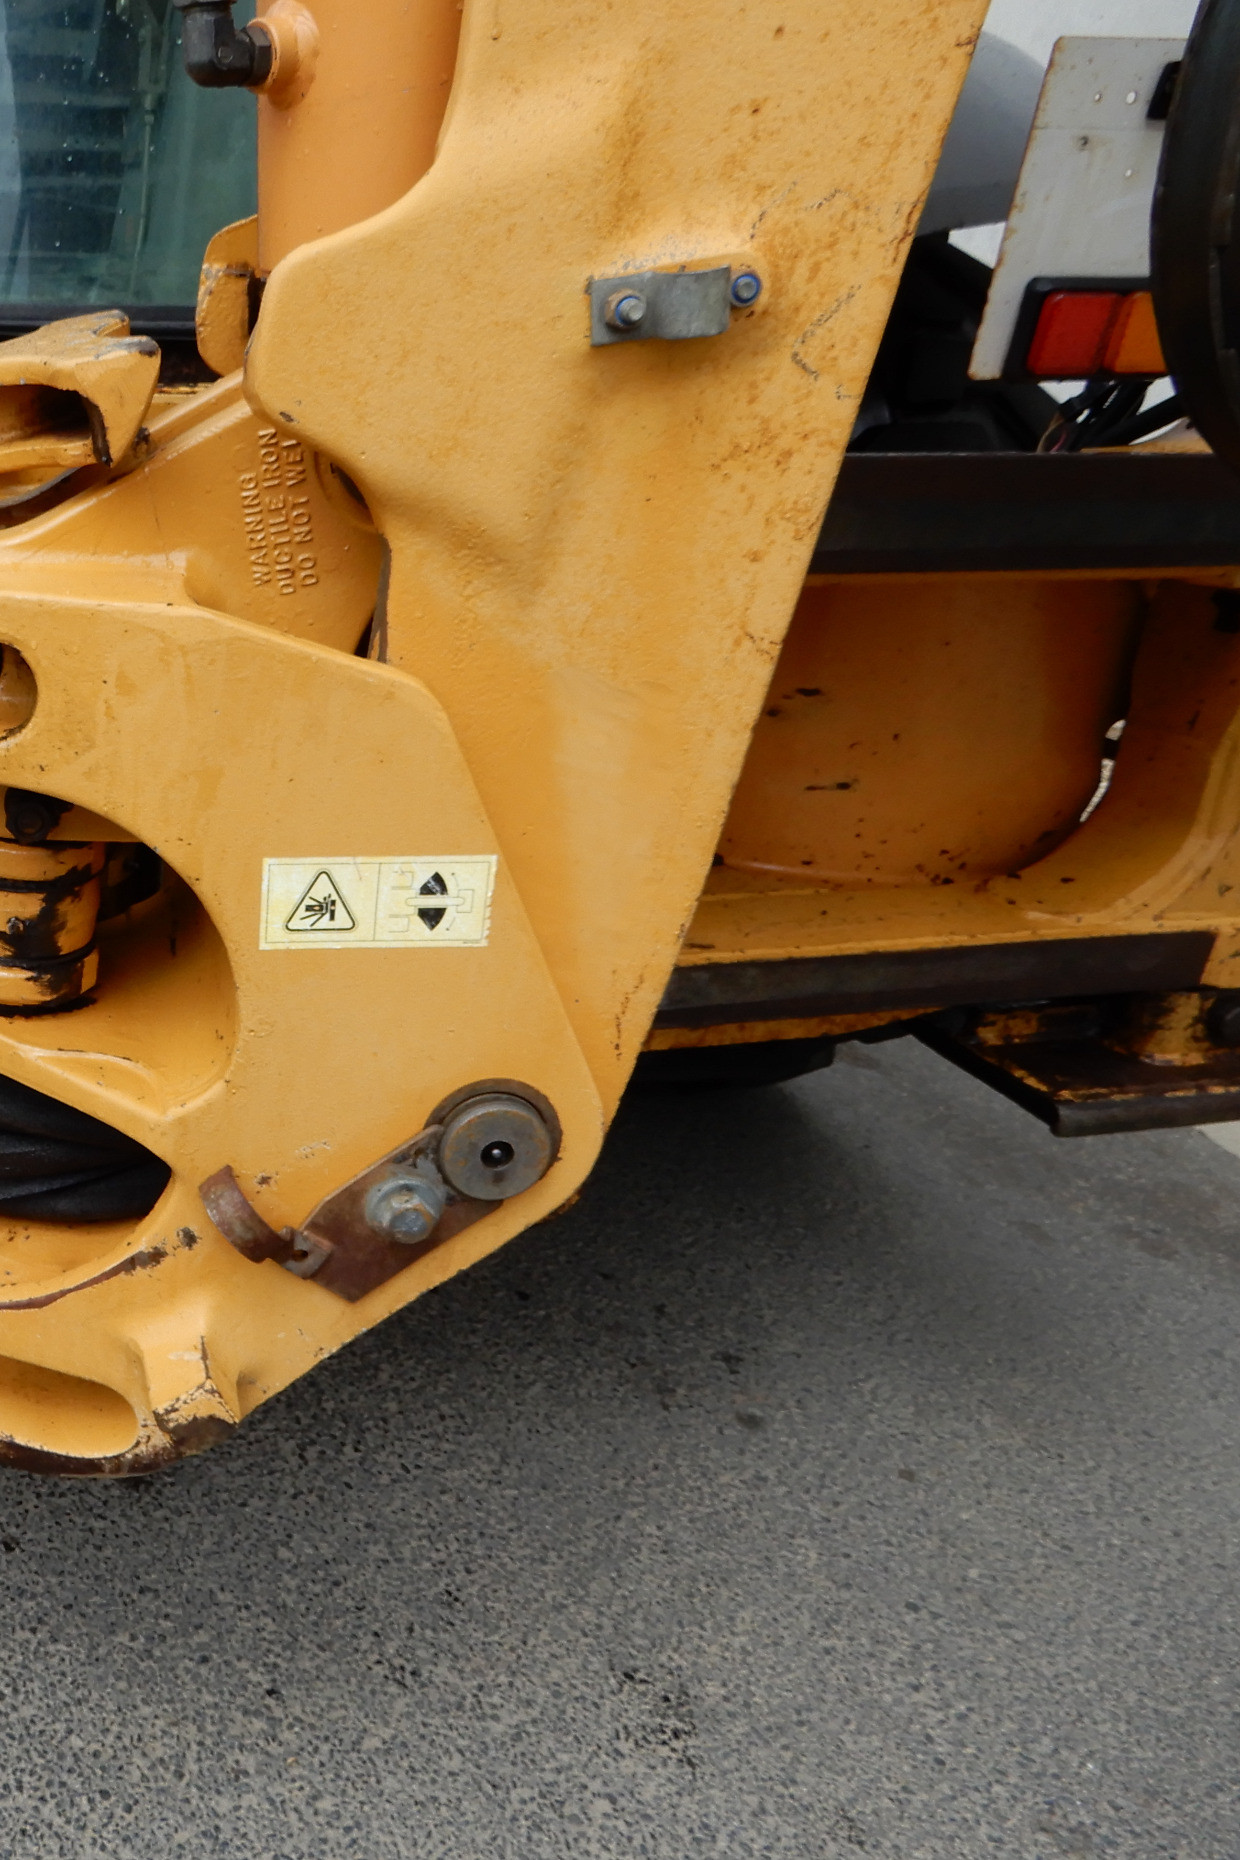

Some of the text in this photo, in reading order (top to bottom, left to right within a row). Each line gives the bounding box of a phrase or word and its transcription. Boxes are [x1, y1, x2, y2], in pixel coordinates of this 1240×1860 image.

[239, 472, 271, 587] WARNING
[258, 428, 296, 596] DUCTILE IRON
[289, 496, 314, 545] NOT
[297, 552, 319, 587] DO
